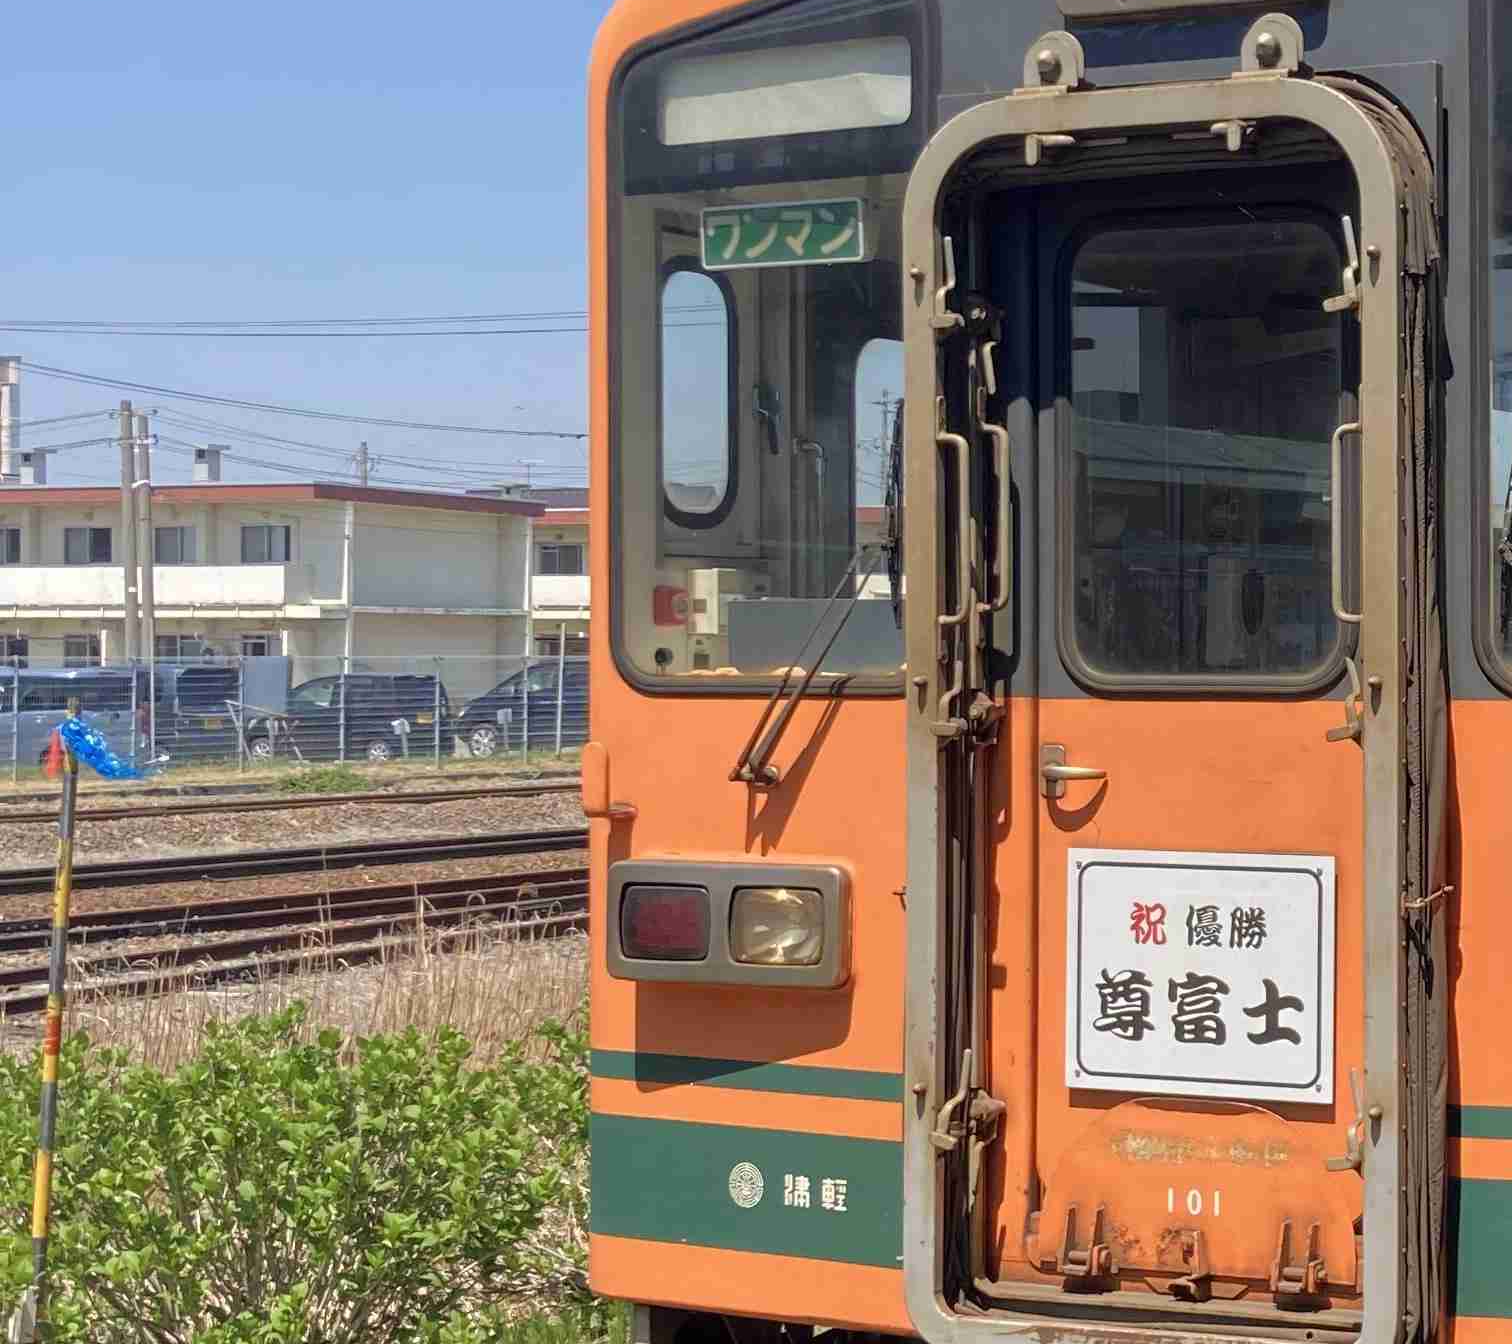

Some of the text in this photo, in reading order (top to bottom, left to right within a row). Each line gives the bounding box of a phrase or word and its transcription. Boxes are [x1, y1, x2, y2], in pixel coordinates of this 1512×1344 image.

[705, 207, 857, 260] ワンマン
[1129, 901, 1269, 950] 祝 優勝
[1092, 967, 1305, 1046] 尊富士
[1167, 1186, 1222, 1217] 101
